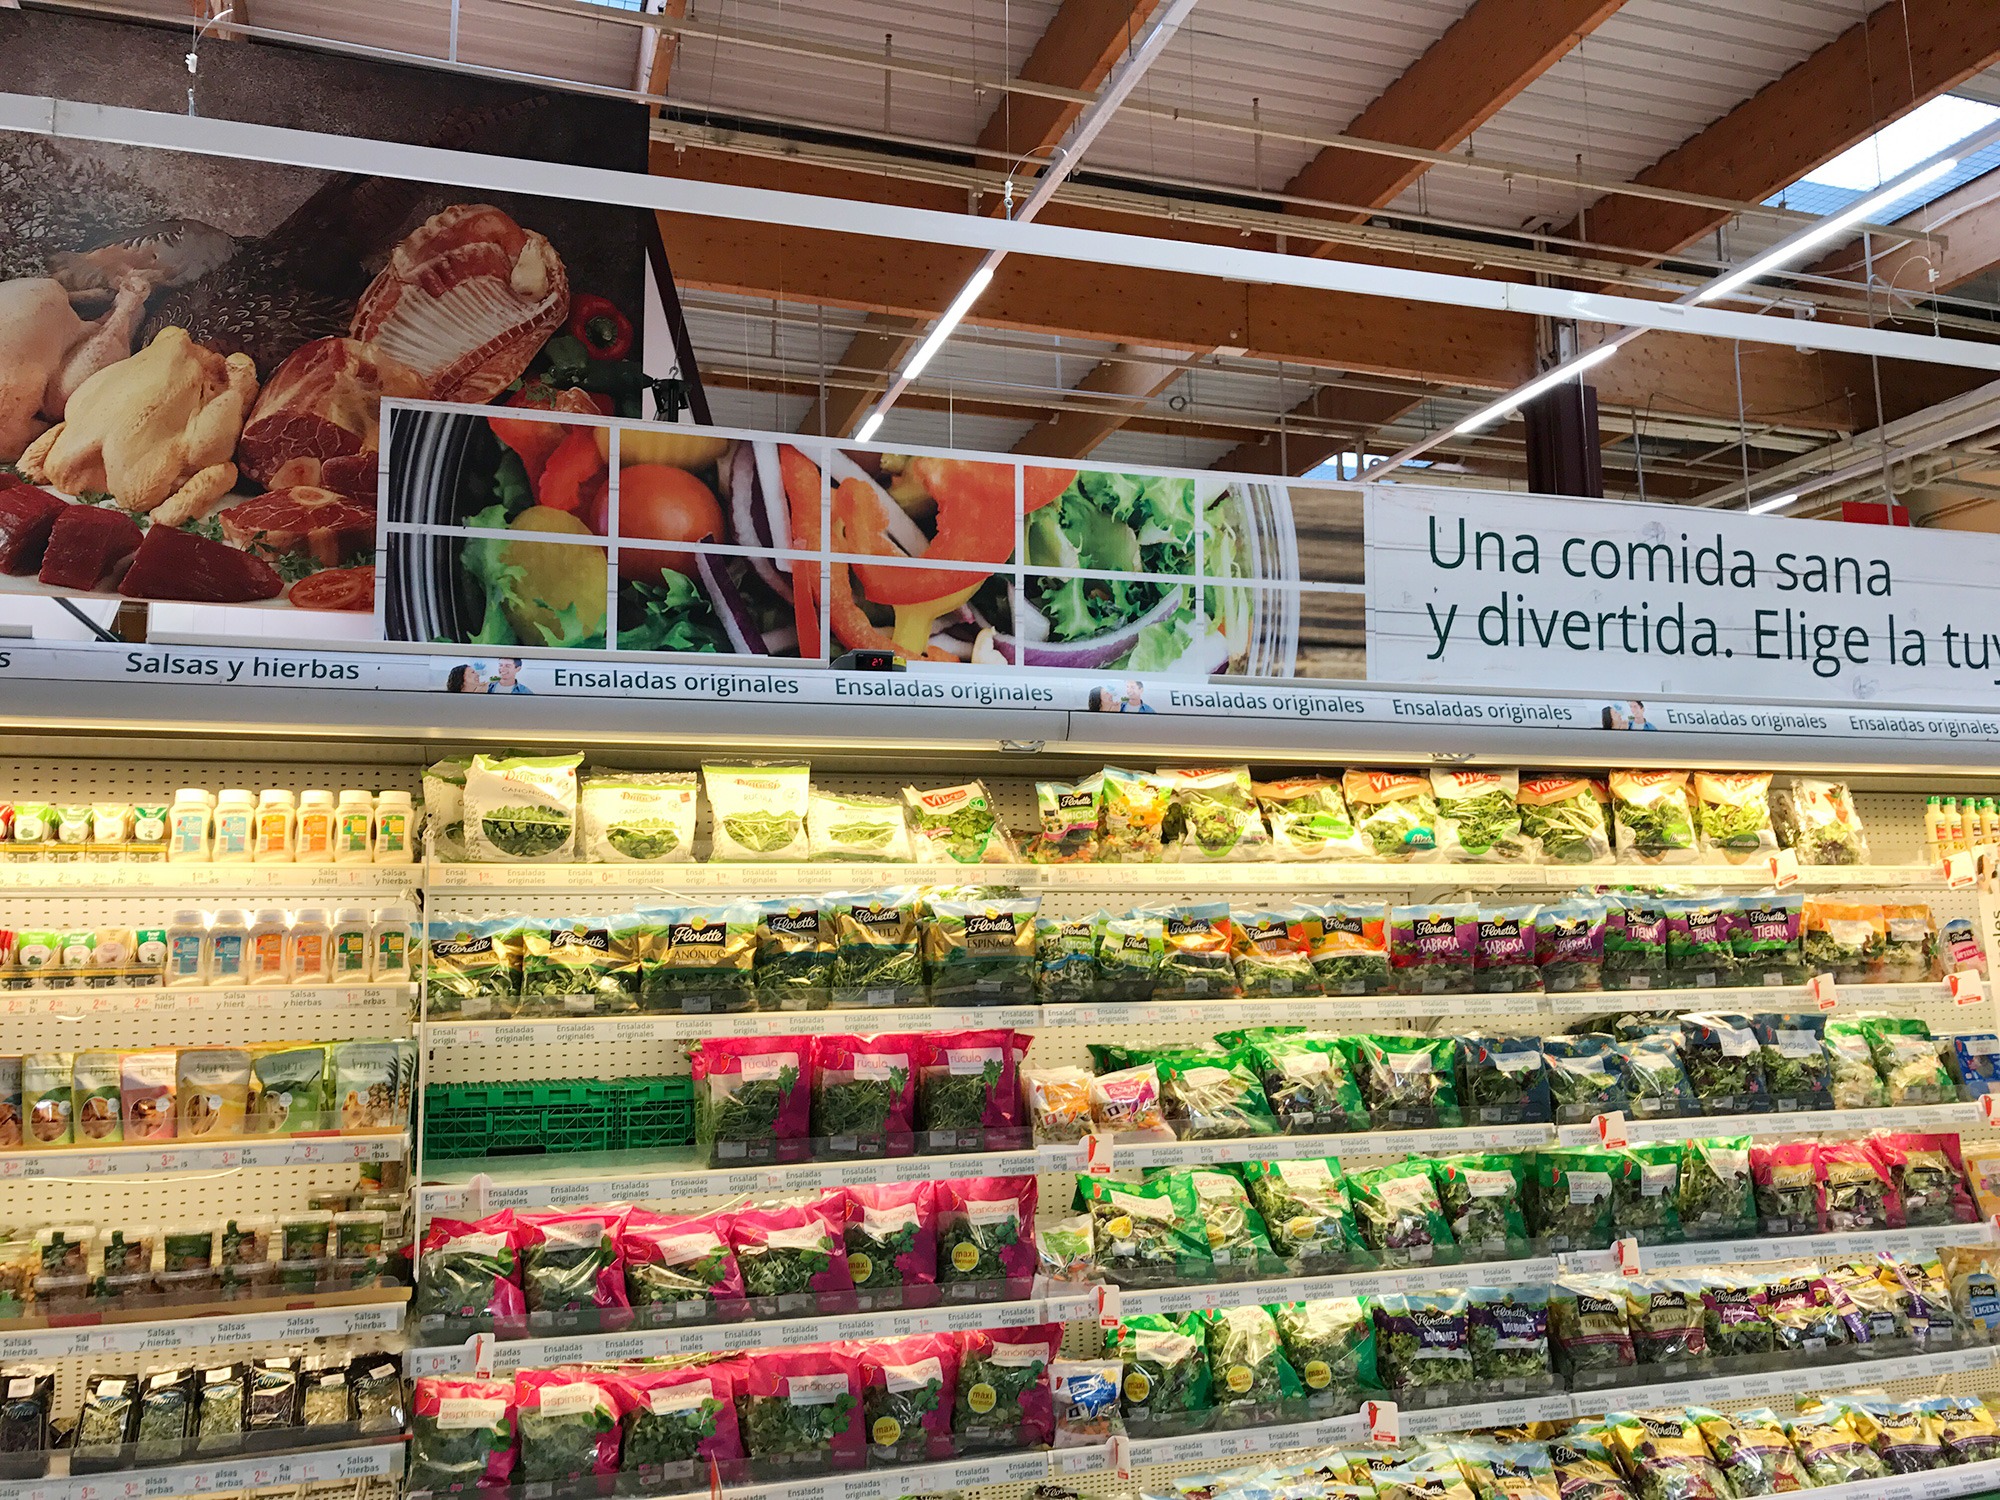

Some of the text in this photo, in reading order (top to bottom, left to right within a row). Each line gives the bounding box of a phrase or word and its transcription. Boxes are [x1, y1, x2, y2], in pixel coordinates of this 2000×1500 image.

[1427, 515, 1893, 606] Una comida sana
[1426, 602, 1459, 661] y
[1477, 592, 1735, 666] divertida.
[1753, 615, 1868, 687] Elige
[1889, 623, 1928, 677] la
[126, 652, 359, 686] Salsas y hierbas
[554, 668, 799, 697] Ensaladas originales
[835, 677, 1053, 705] Ensaladas originales
[1170, 690, 1365, 716] Ensaladas originales
[1392, 699, 1573, 724] Ensaladas originales
[1666, 708, 1828, 732] Ensaladas originales
[1849, 715, 1999, 740] Ensaladas originales
[1061, 795, 1091, 807] Florette
[1063, 810, 1095, 820] MICRO
[382, 876, 412, 884] hierbas
[855, 910, 898, 924] Florette
[1750, 912, 1787, 924] Florette
[772, 917, 817, 933] Florette
[969, 917, 1012, 933] Florette
[1171, 922, 1209, 935] Florette
[1325, 918, 1361, 933] Florette
[1417, 922, 1454, 935] Florette
[1063, 926, 1091, 936] Florette
[1247, 928, 1286, 939] Florette
[1482, 924, 1518, 937] Florette
[1628, 925, 1659, 939] TIERNA
[1754, 924, 1788, 938] TIERNA
[672, 926, 723, 947] Florette
[437, 939, 492, 954] Florette
[967, 937, 1015, 951] ESPINACA
[1066, 940, 1092, 949] MICRO
[1420, 936, 1459, 953] SABROSA
[1484, 937, 1525, 954] SABROSA
[290, 998, 322, 1006] hierbas
[790, 1016, 824, 1024] Ensaladas
[495, 1026, 534, 1034] Ensaladas
[557, 1024, 595, 1032] Ensaladas
[617, 1022, 654, 1030] Ensaladas
[790, 1024, 824, 1032] originales
[557, 1032, 595, 1041] originales
[676, 1028, 712, 1037] originales
[495, 1034, 534, 1042] originales
[744, 1058, 778, 1069] rúcula
[857, 1058, 888, 1069] rúcula
[950, 1053, 982, 1064] rúcula
[896, 1164, 930, 1174] Ensaladas
[950, 1161, 983, 1171] Ensaladas
[786, 1169, 822, 1179] Ensaladas
[842, 1167, 877, 1177] Ensaladas
[950, 1170, 983, 1180] originales
[842, 1176, 877, 1187] originales
[897, 1174, 930, 1184] originales
[551, 1185, 589, 1194] Ensaladas
[612, 1182, 649, 1190] Ensaladas
[786, 1179, 822, 1190] originales
[489, 1189, 528, 1197] Ensaladas
[612, 1190, 649, 1200] originales
[489, 1197, 528, 1207] originales
[551, 1194, 589, 1203] originales
[955, 1250, 976, 1260] maxi
[849, 1260, 869, 1270] maxi
[1770, 1280, 1808, 1296] Florette
[1715, 1289, 1750, 1304] Florette
[1581, 1300, 1618, 1314] Florette
[1651, 1295, 1685, 1309] Florette
[355, 1312, 381, 1320] Salsas
[948, 1312, 982, 1322] Ensaladas
[1492, 1305, 1529, 1319] Florette
[287, 1317, 314, 1326] Salsas
[354, 1320, 386, 1329] hierbas
[839, 1320, 874, 1330] Ensaladas
[948, 1320, 982, 1330] originales
[1414, 1315, 1453, 1327] Florette
[287, 1326, 320, 1335] hierbas
[725, 1330, 762, 1339] Ensaladas
[782, 1325, 818, 1334] Ensaladas
[839, 1329, 874, 1338] originales
[147, 1337, 181, 1347] hierbas
[725, 1338, 762, 1347] originales
[783, 1333, 818, 1342] originales
[1230, 1374, 1249, 1382] maxi
[1308, 1369, 1327, 1377] maxi
[791, 1381, 847, 1391] canónigos
[1128, 1382, 1146, 1390] maxi
[972, 1390, 993, 1400] maxi
[442, 1410, 496, 1420] espinaca
[876, 1424, 897, 1435] maxi
[1647, 1418, 1683, 1437] Florette
[347, 1456, 373, 1464] Salsas
[347, 1463, 379, 1474] hierbas
[956, 1466, 990, 1477] Ensaladas
[956, 1474, 990, 1485] originales
[845, 1480, 881, 1491] Ensaladas
[846, 1489, 881, 1499] originales
